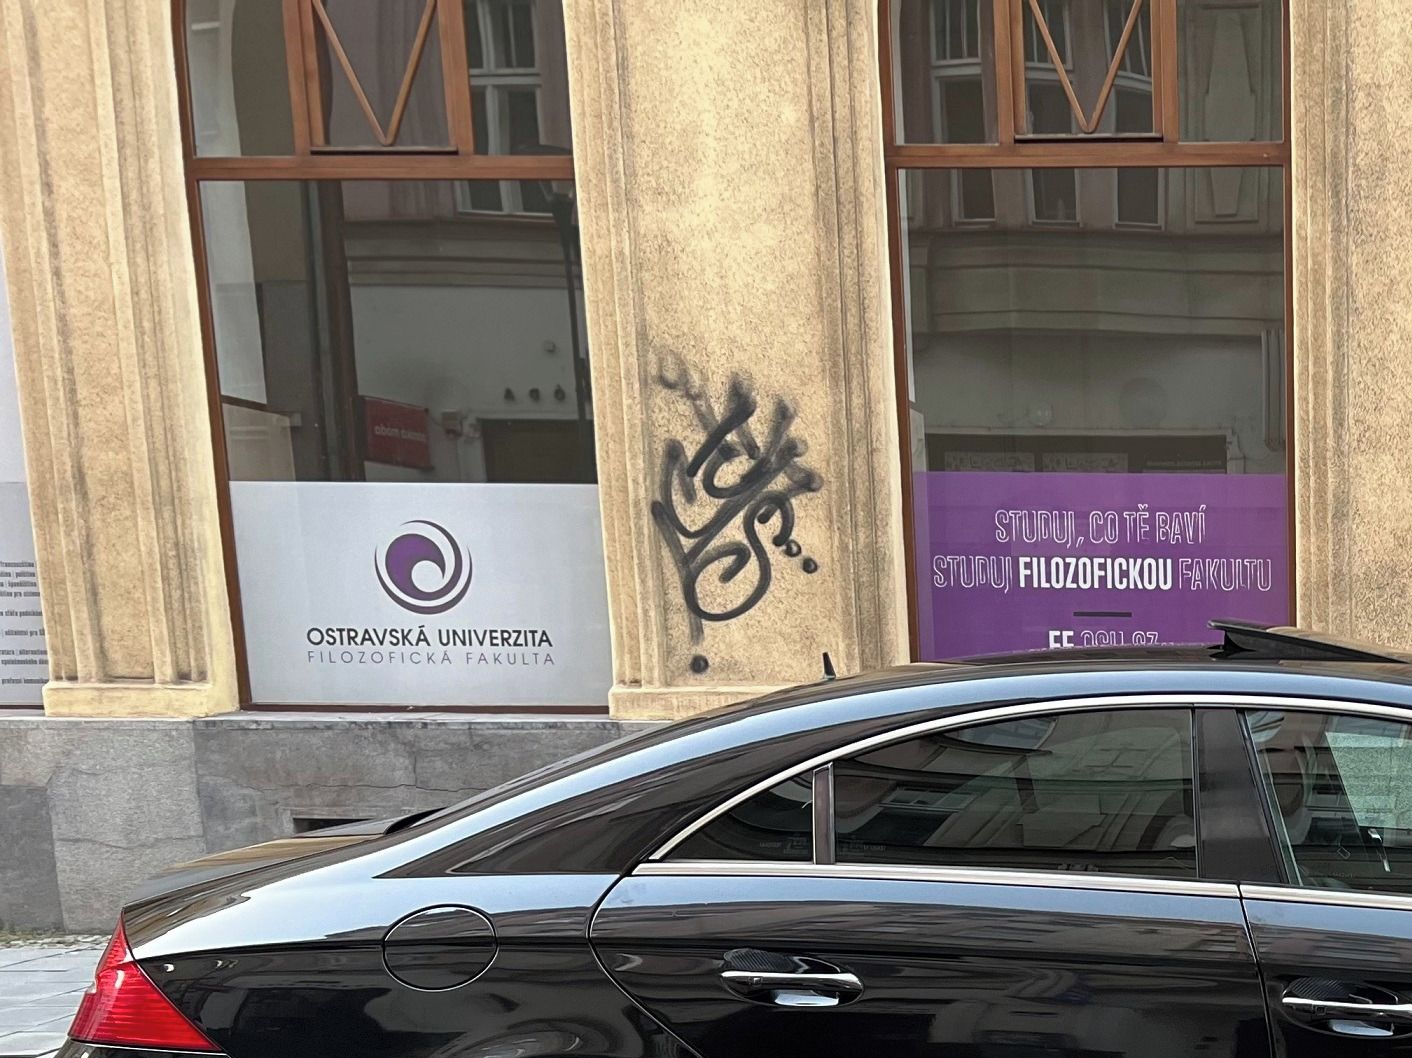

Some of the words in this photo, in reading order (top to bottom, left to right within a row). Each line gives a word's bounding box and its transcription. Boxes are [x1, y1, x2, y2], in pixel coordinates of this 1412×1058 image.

[994, 509, 1085, 549] STUDUJ,
[1089, 511, 1119, 544] CO
[1123, 503, 1150, 544] TĚ
[1155, 504, 1207, 545] BAVÍ
[933, 555, 1012, 594] STUDUJ
[1018, 556, 1173, 590] FILOZOFICKOU
[1178, 558, 1272, 592] FAKULTU
[306, 625, 431, 647] OSTRAVSKÁ
[438, 629, 553, 648] UNIVERZITA
[307, 650, 452, 665] FILOZOFICKÁ
[466, 652, 555, 665] FAKULTA
